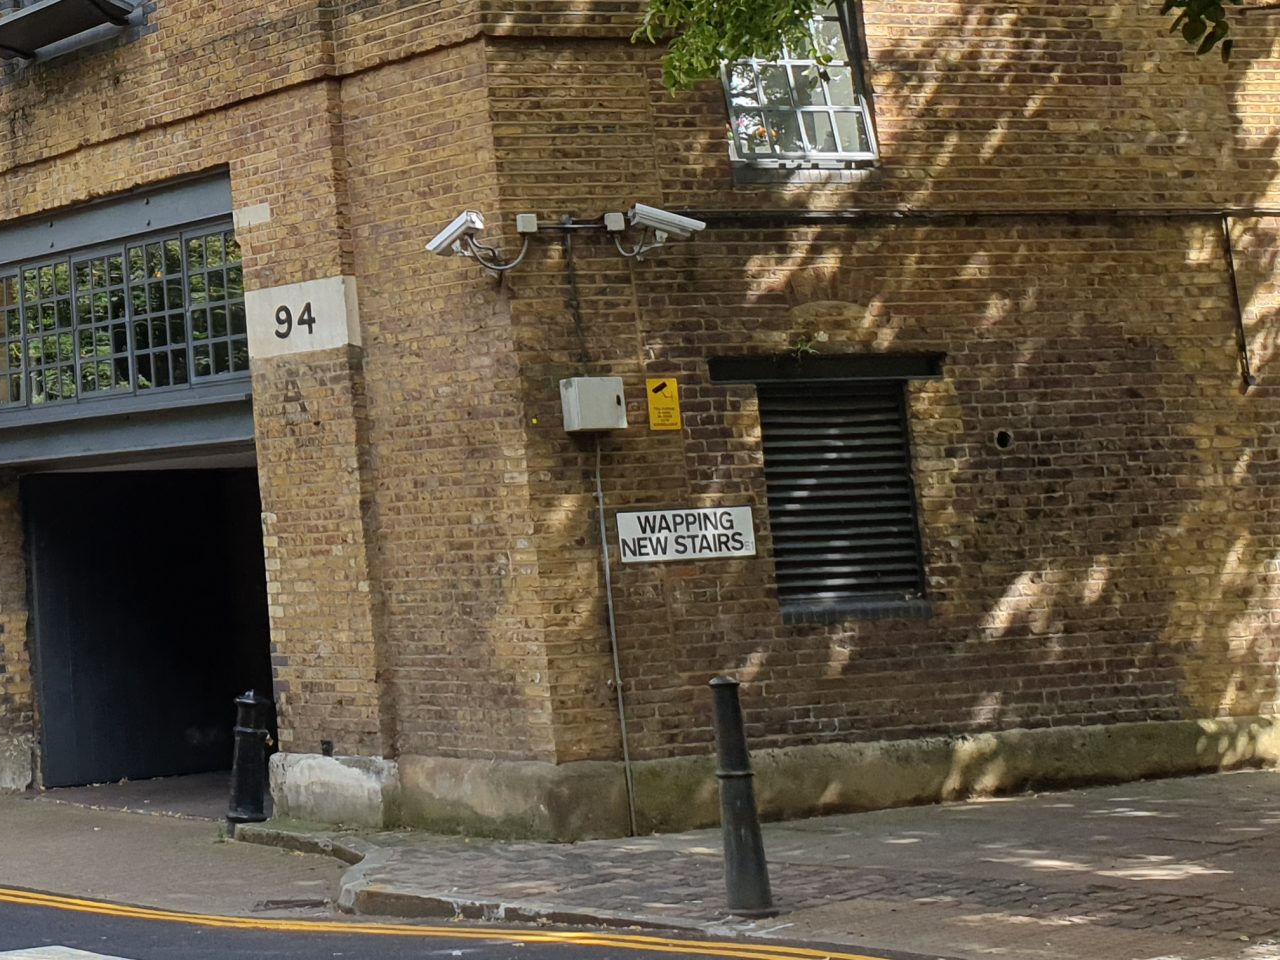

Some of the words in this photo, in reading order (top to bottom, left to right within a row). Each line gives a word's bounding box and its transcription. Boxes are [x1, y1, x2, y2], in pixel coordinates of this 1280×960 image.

[274, 300, 317, 340] 94
[636, 511, 734, 535] WAPPING
[621, 536, 669, 558] NEW
[674, 531, 744, 555] STAIRS
